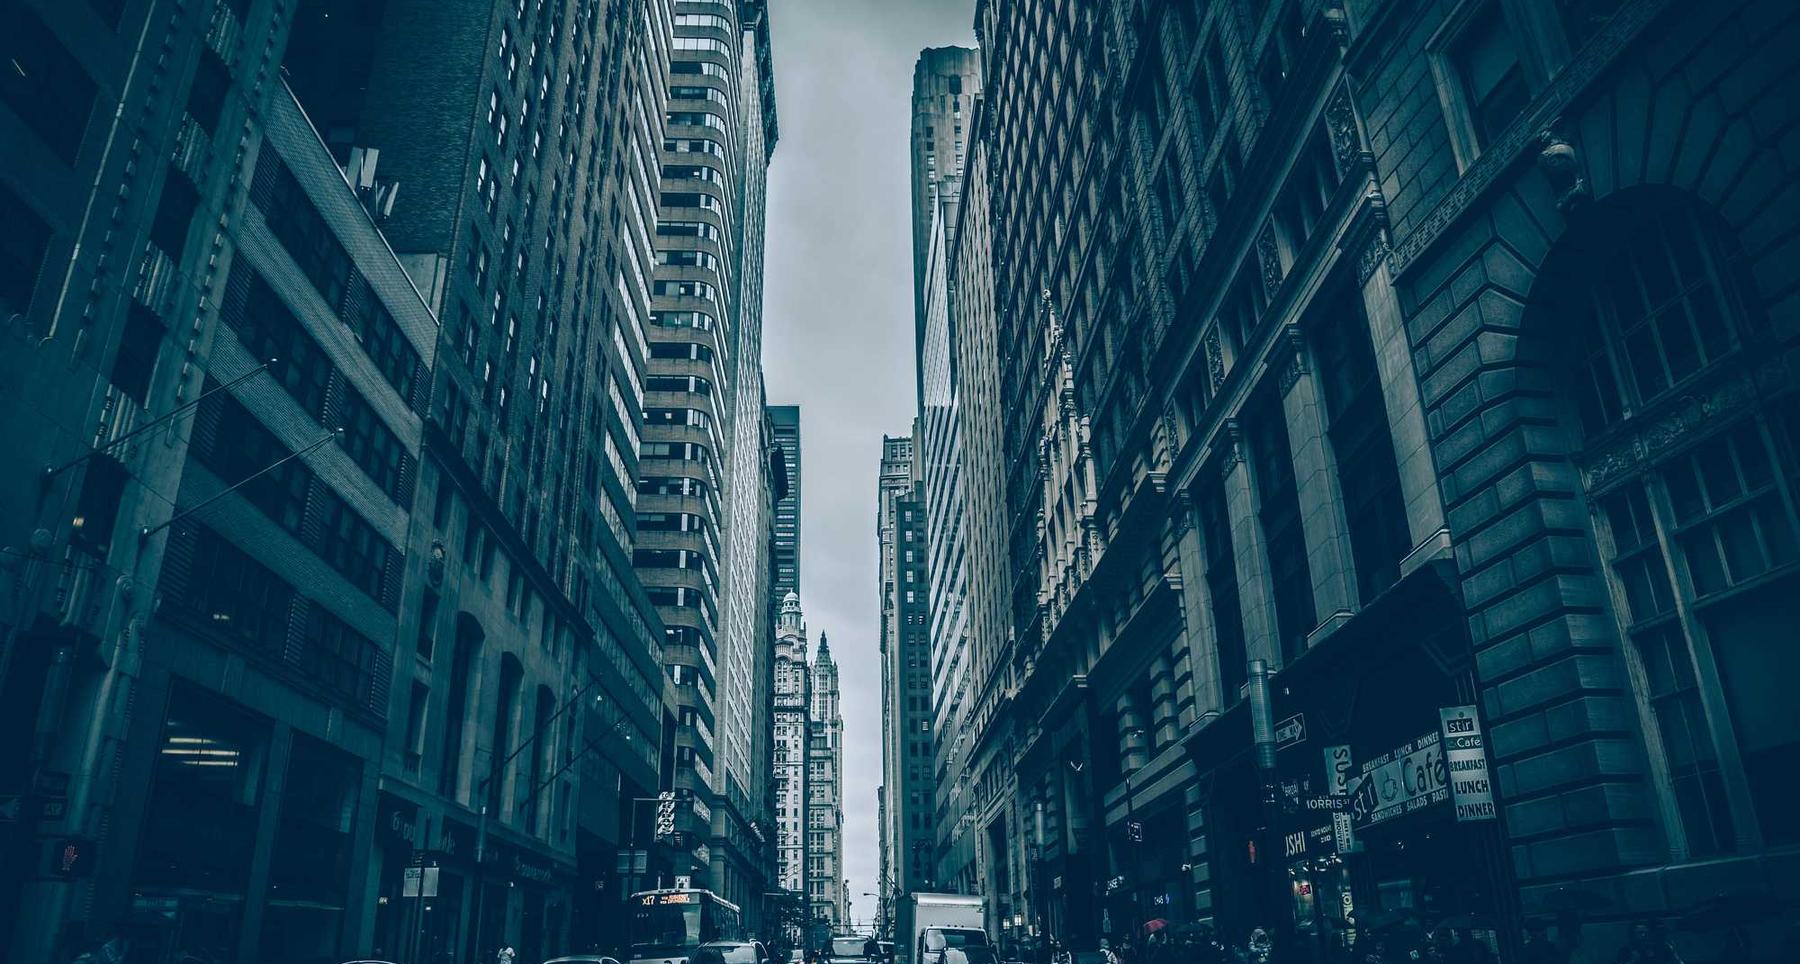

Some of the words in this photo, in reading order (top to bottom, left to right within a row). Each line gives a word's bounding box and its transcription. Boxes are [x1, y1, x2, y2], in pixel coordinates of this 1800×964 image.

[1449, 719, 1472, 733] stir
[1456, 737, 1481, 748] Café
[1449, 758, 1487, 772] BREAKFAST
[1402, 750, 1447, 796] Café
[1455, 779, 1489, 795] LUNCH
[1406, 795, 1428, 812] SALADS
[1457, 802, 1495, 817] DINNER
